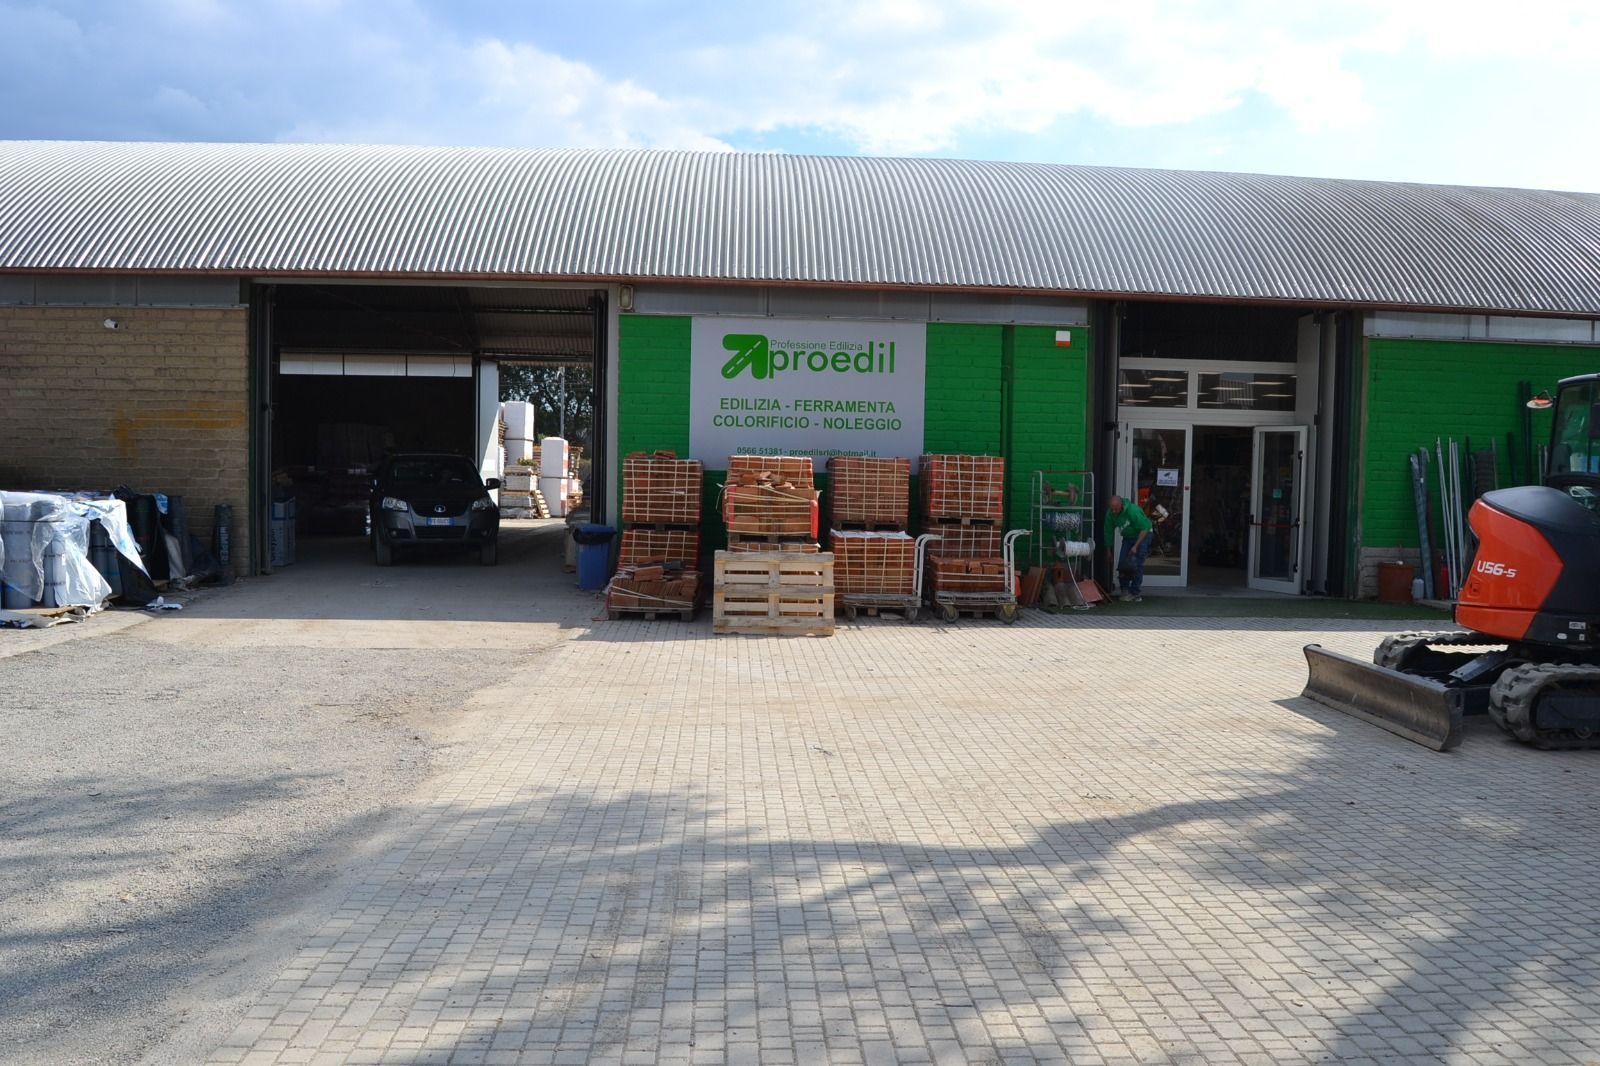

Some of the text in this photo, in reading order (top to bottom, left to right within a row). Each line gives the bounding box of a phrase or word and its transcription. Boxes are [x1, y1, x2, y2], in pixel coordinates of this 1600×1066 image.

[770, 340, 863, 351] Professione Edilizia
[769, 341, 895, 379] proedil
[720, 398, 781, 411] EDILIZIA
[794, 399, 896, 413] FERRAMENTA
[713, 414, 810, 429] COLORIFICIO
[823, 417, 902, 431] NOLEGGIO
[737, 446, 757, 455] 0566
[759, 447, 782, 456] 51381
